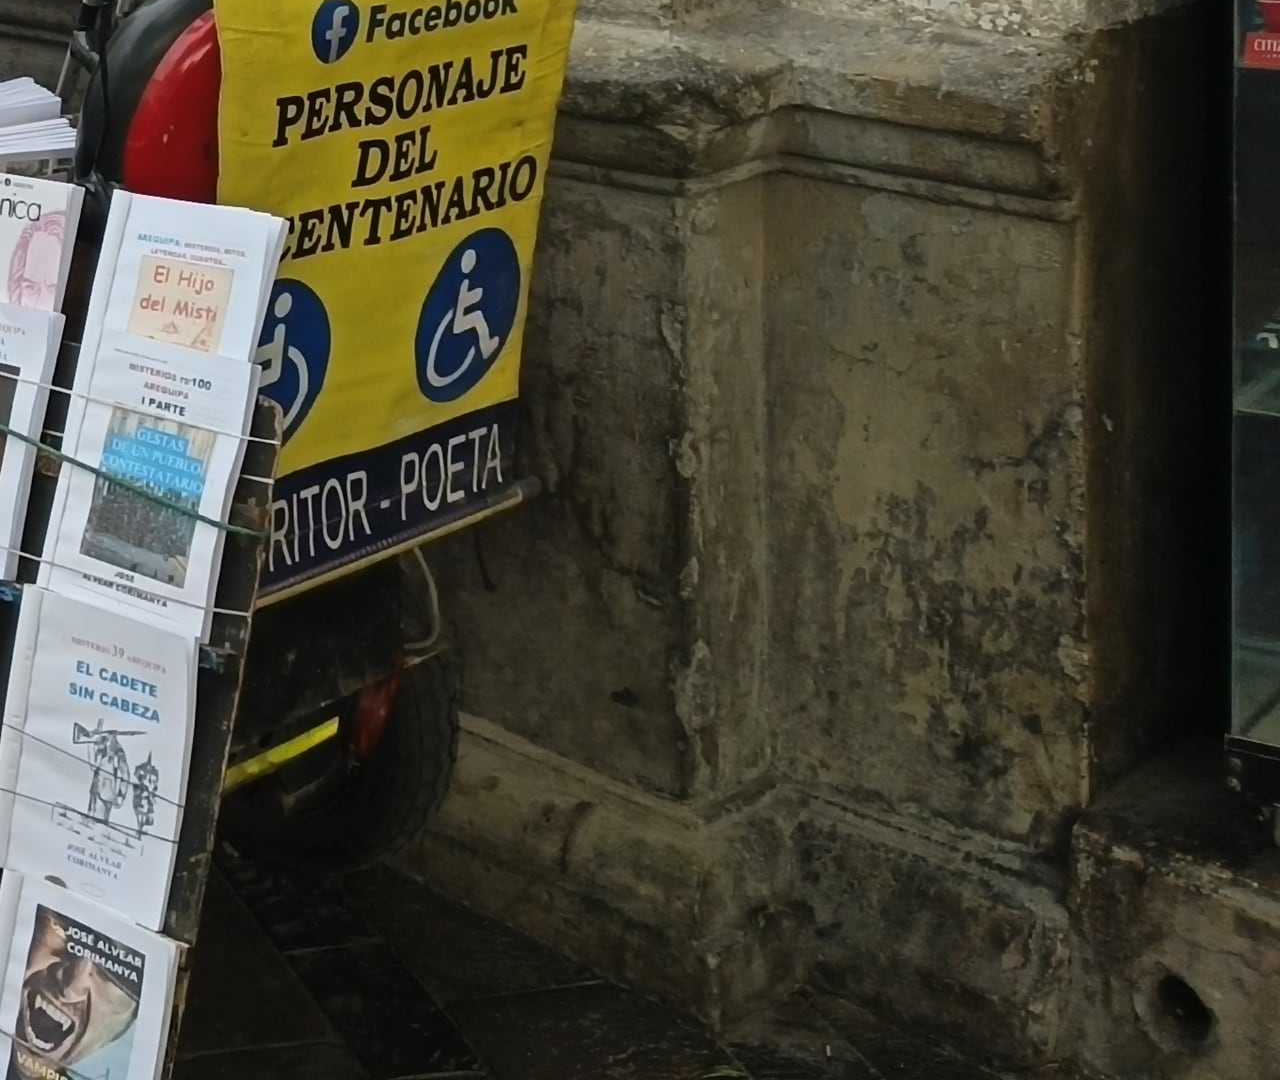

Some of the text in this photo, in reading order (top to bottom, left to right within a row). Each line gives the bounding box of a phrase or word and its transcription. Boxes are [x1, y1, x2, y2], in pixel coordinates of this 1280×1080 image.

[272, 44, 528, 148] PERSONAJE
[351, 125, 438, 188] DEL
[153, 265, 215, 295] El Hijo
[140, 294, 219, 323] del Misti
[148, 396, 187, 417] PARTE
[111, 438, 203, 475] DE UN PUEBLO
[137, 428, 185, 453] GESTAS
[101, 452, 205, 494] CONTESTATARIO
[400, 423, 503, 521] POETA
[111, 644, 126, 659] 39
[76, 659, 158, 698] EL CADETE
[69, 682, 160, 723] SIN CABEZA
[66, 926, 143, 967] JOSÉ ALVEAR
[66, 942, 139, 983] CORIMANYA
